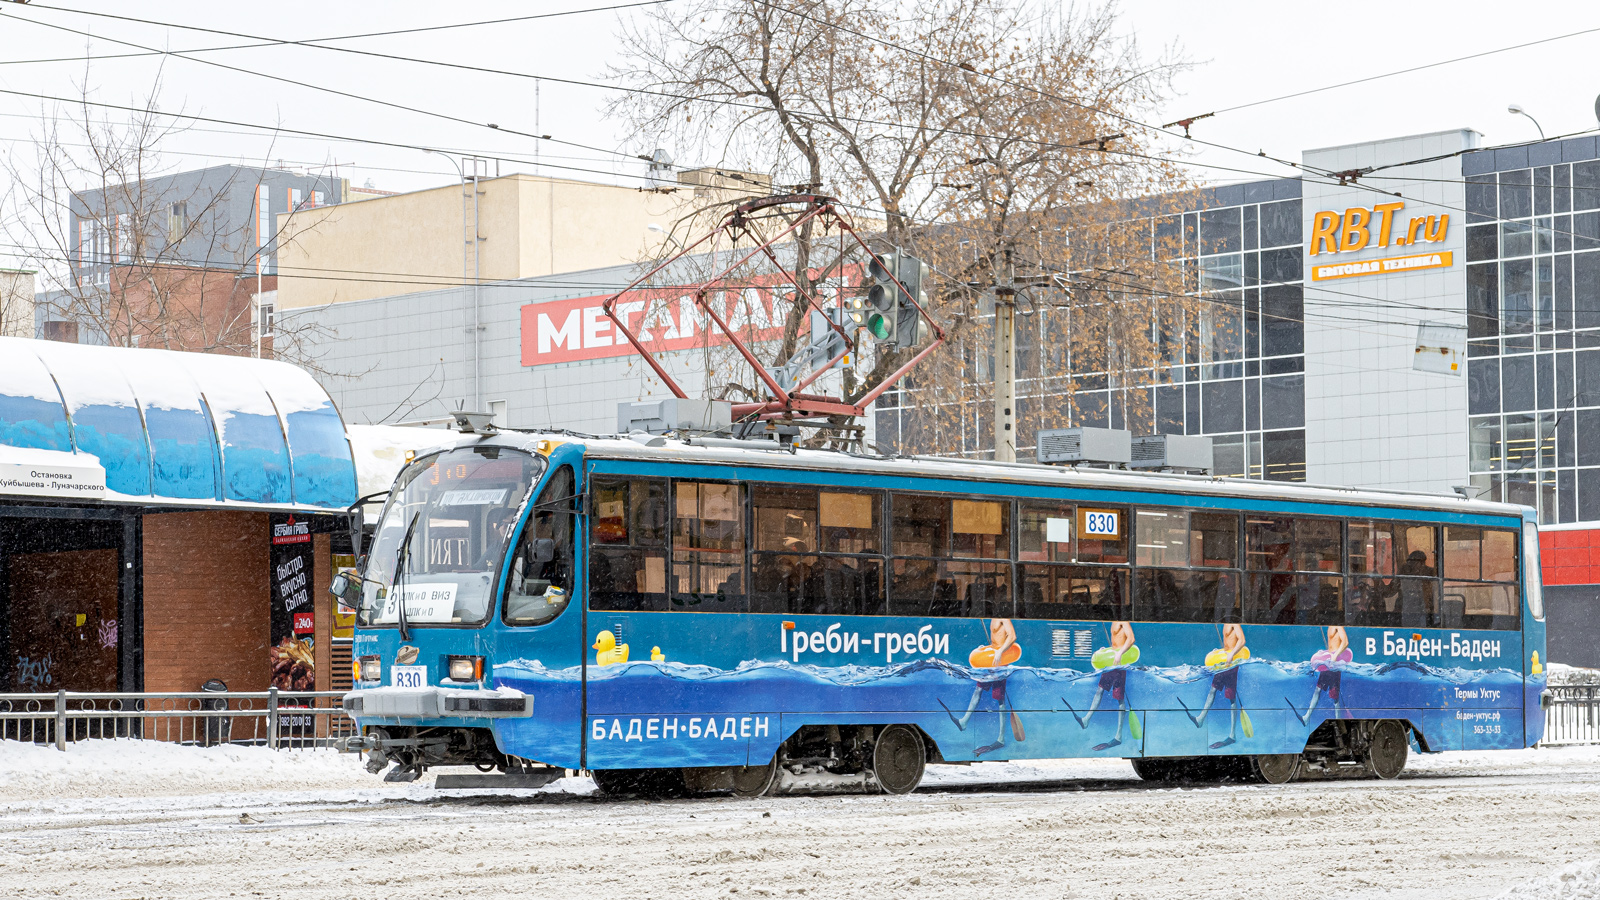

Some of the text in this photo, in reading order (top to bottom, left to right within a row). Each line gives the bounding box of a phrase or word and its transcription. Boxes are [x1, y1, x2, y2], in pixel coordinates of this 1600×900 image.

[1309, 201, 1450, 256] RBT.ru
[1318, 255, 1442, 278] БЫТОВАЯ ТЕХНИКА
[30, 470, 73, 480] Остановка
[51, 481, 105, 491] Луначарского
[1089, 514, 1114, 533] 830
[388, 592, 398, 615] 3
[431, 590, 451, 601] ВИЗ
[299, 617, 311, 629] 240
[781, 622, 949, 663] Греби-греби
[1365, 631, 1501, 662] в Баден-Баден
[397, 672, 421, 688] 830
[1454, 687, 1501, 702] Термы Уктус
